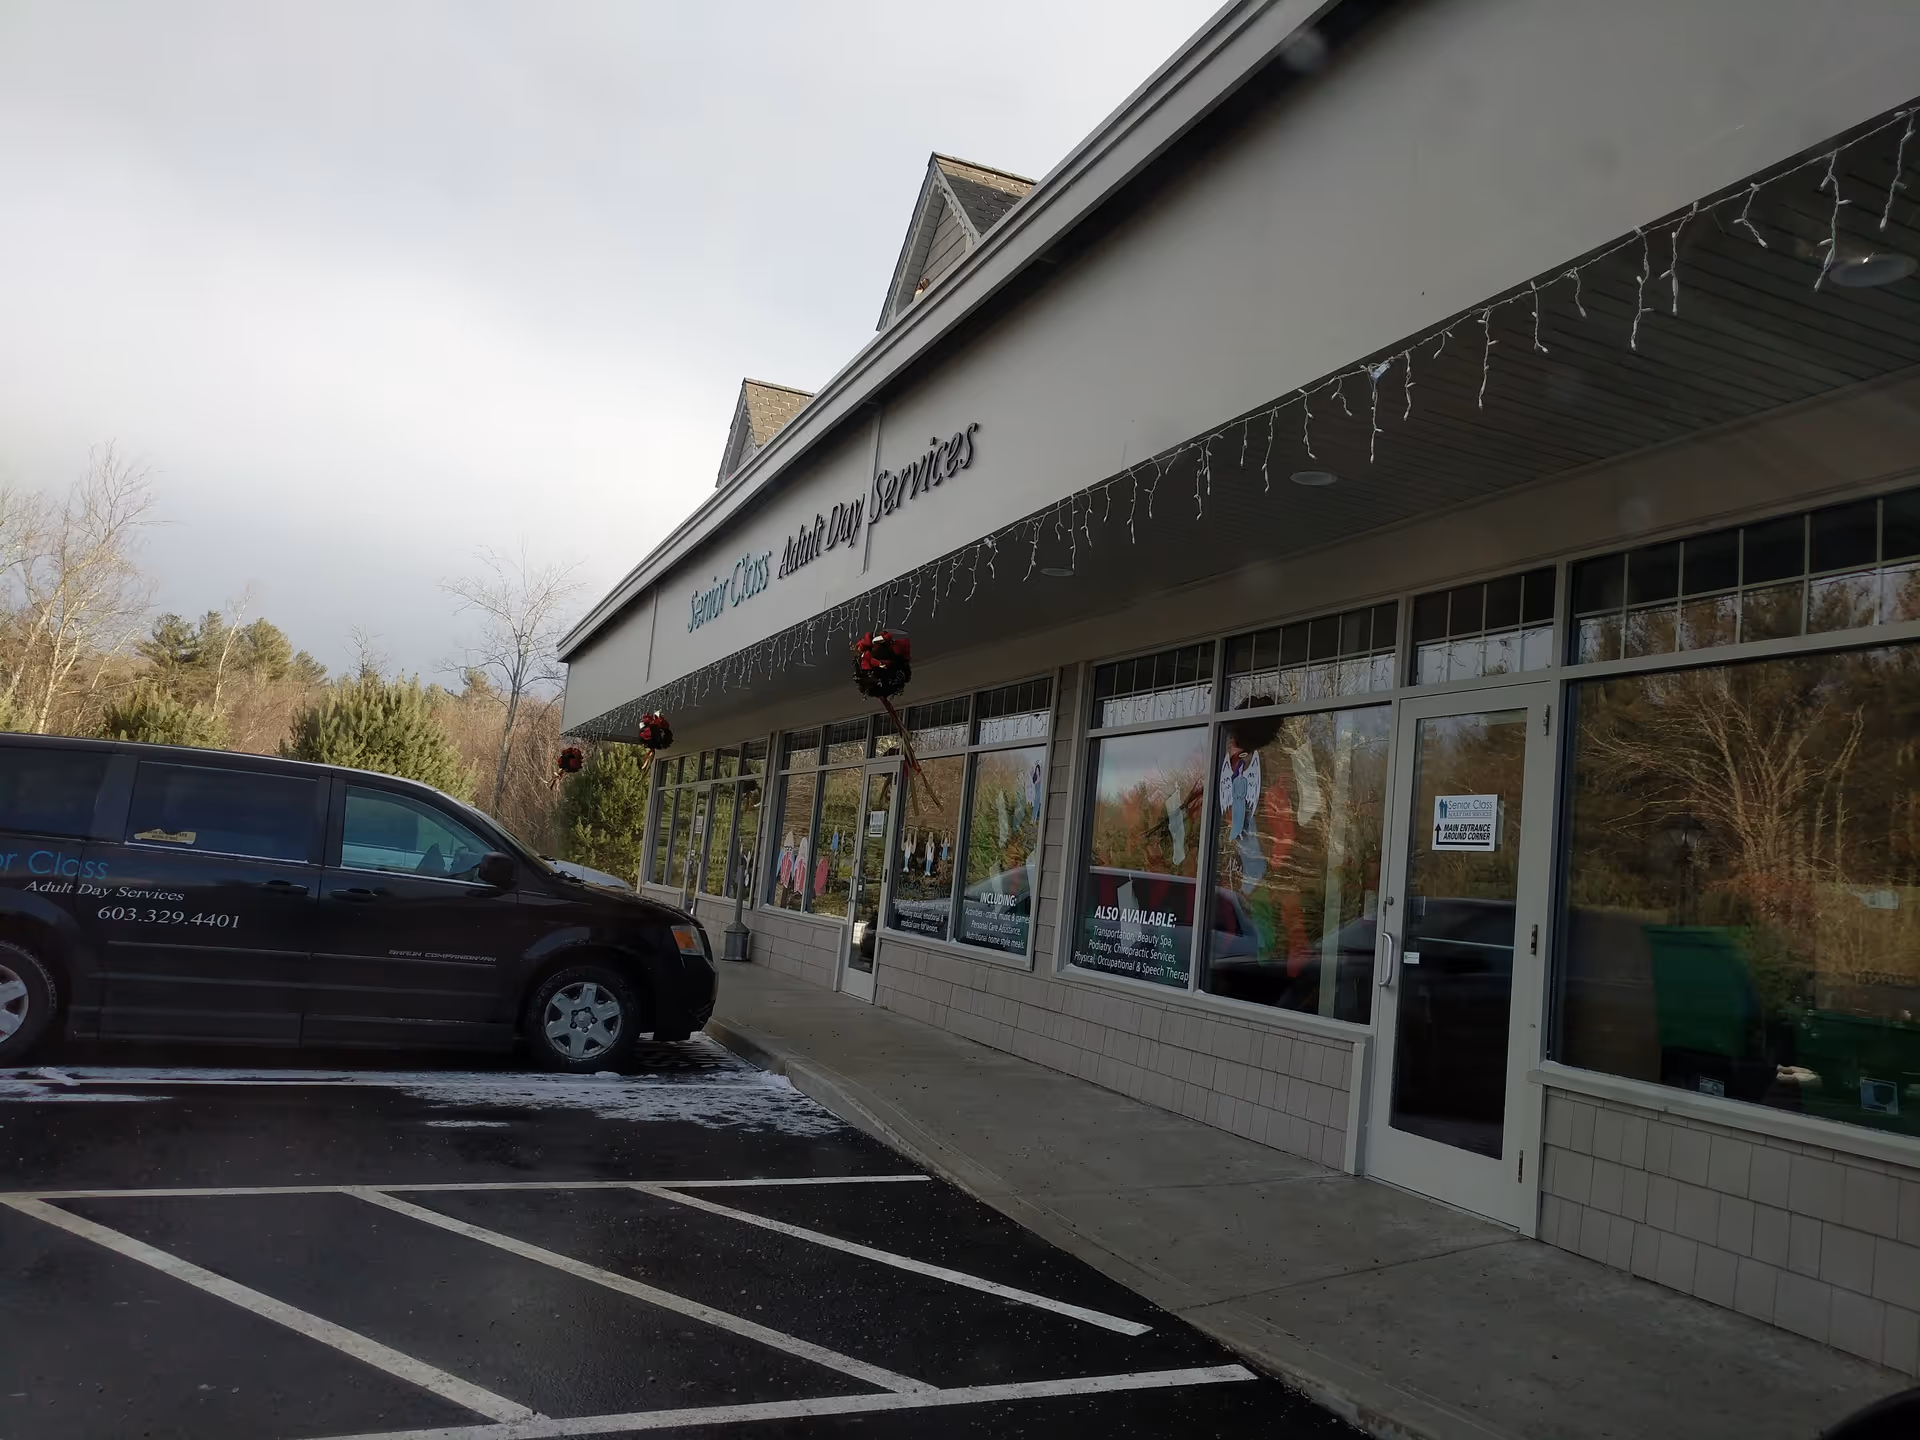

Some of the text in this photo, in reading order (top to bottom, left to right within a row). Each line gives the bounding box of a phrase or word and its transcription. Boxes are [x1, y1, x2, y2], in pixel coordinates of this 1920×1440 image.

[687, 422, 979, 633] Senior Class Adult Day Services
[1448, 799, 1493, 810] Senior Class
[1443, 823, 1491, 832] MAIN ENTRANCE
[1443, 832, 1491, 841] AROUND CORNER
[28, 850, 109, 880] Class
[22, 880, 185, 901] Adult Day Services
[980, 892, 1017, 907] INCLUDING:
[97, 906, 240, 928] 603.329.4401
[1094, 905, 1177, 928] ALSO AVAILABLE:
[1093, 925, 1173, 949] Transportation, Beauty Spa,
[1088, 939, 1177, 964] Podiatry, Chiropractic Services,
[1097, 955, 1135, 971] Occupational
[1136, 961, 1141, 972] &
[1142, 963, 1164, 977] Speech
[1166, 967, 1190, 984] Therap
